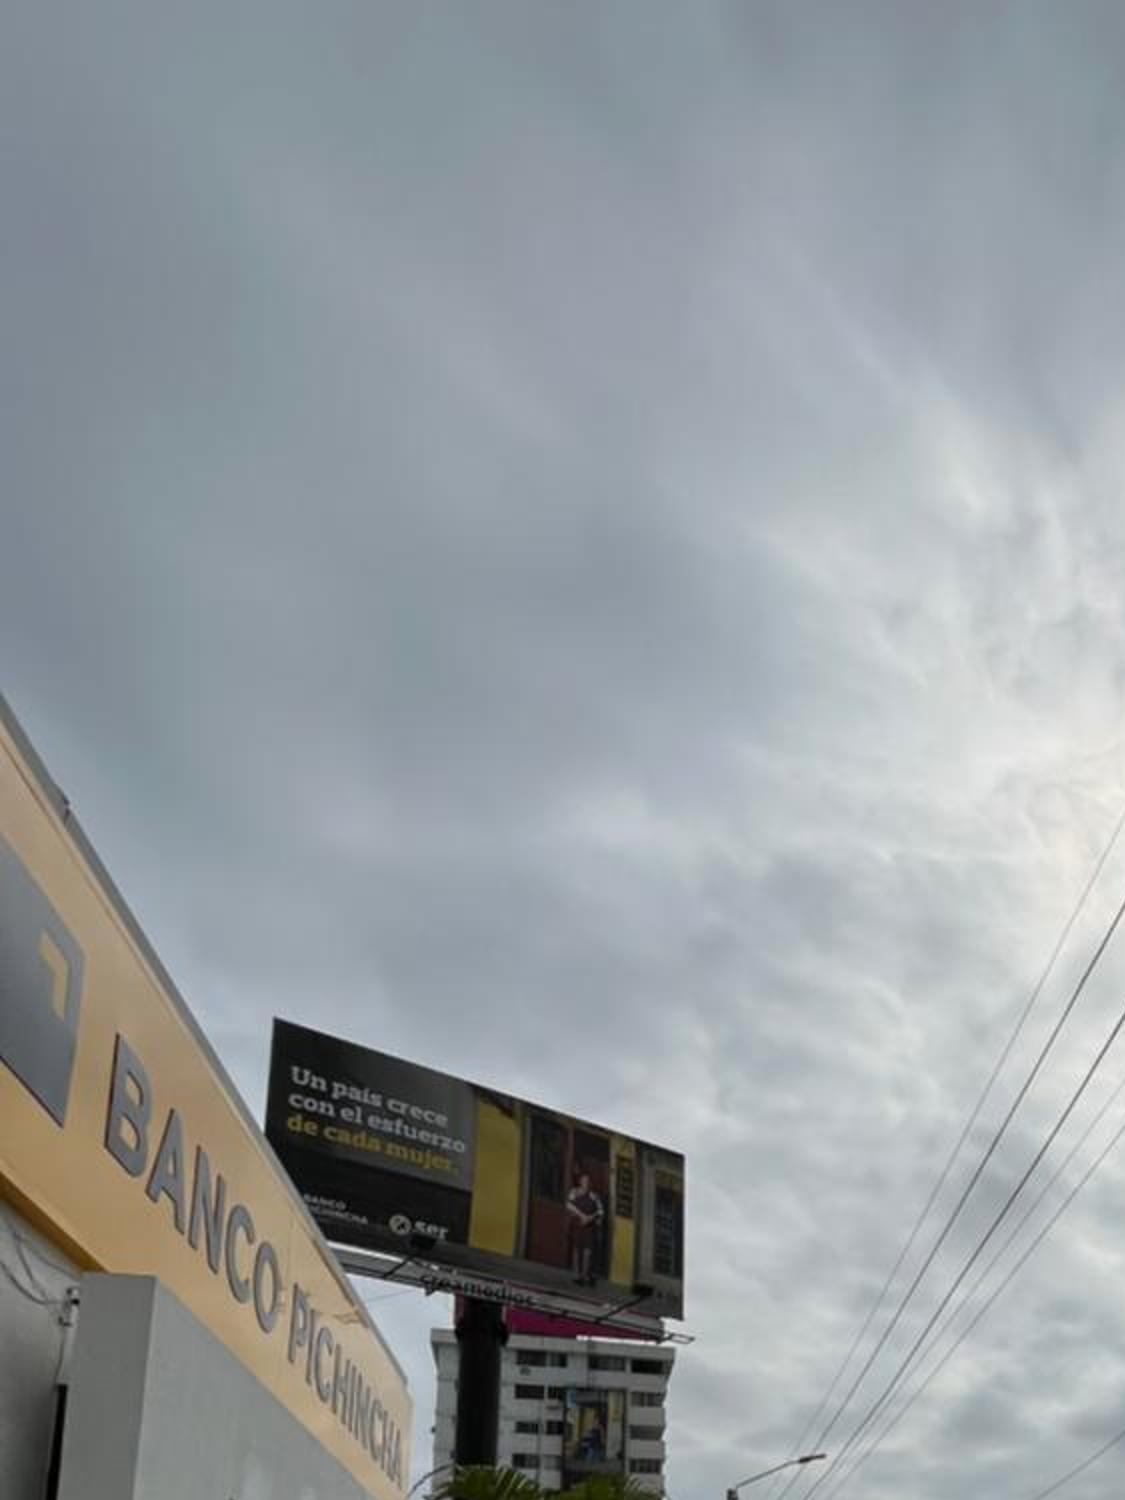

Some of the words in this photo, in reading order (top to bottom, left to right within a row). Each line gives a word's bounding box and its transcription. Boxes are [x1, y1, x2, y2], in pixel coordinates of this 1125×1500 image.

[288, 1093, 335, 1117] con
[340, 1106, 363, 1124] el
[367, 1116, 466, 1153] esfuerzo
[290, 1066, 327, 1092] Un
[331, 1081, 383, 1108] país
[386, 1098, 449, 1128] crece
[287, 1114, 319, 1135] de
[323, 1126, 381, 1150] cada
[104, 1033, 283, 1334] BANCO
[287, 1282, 403, 1491] PICHINCHA
